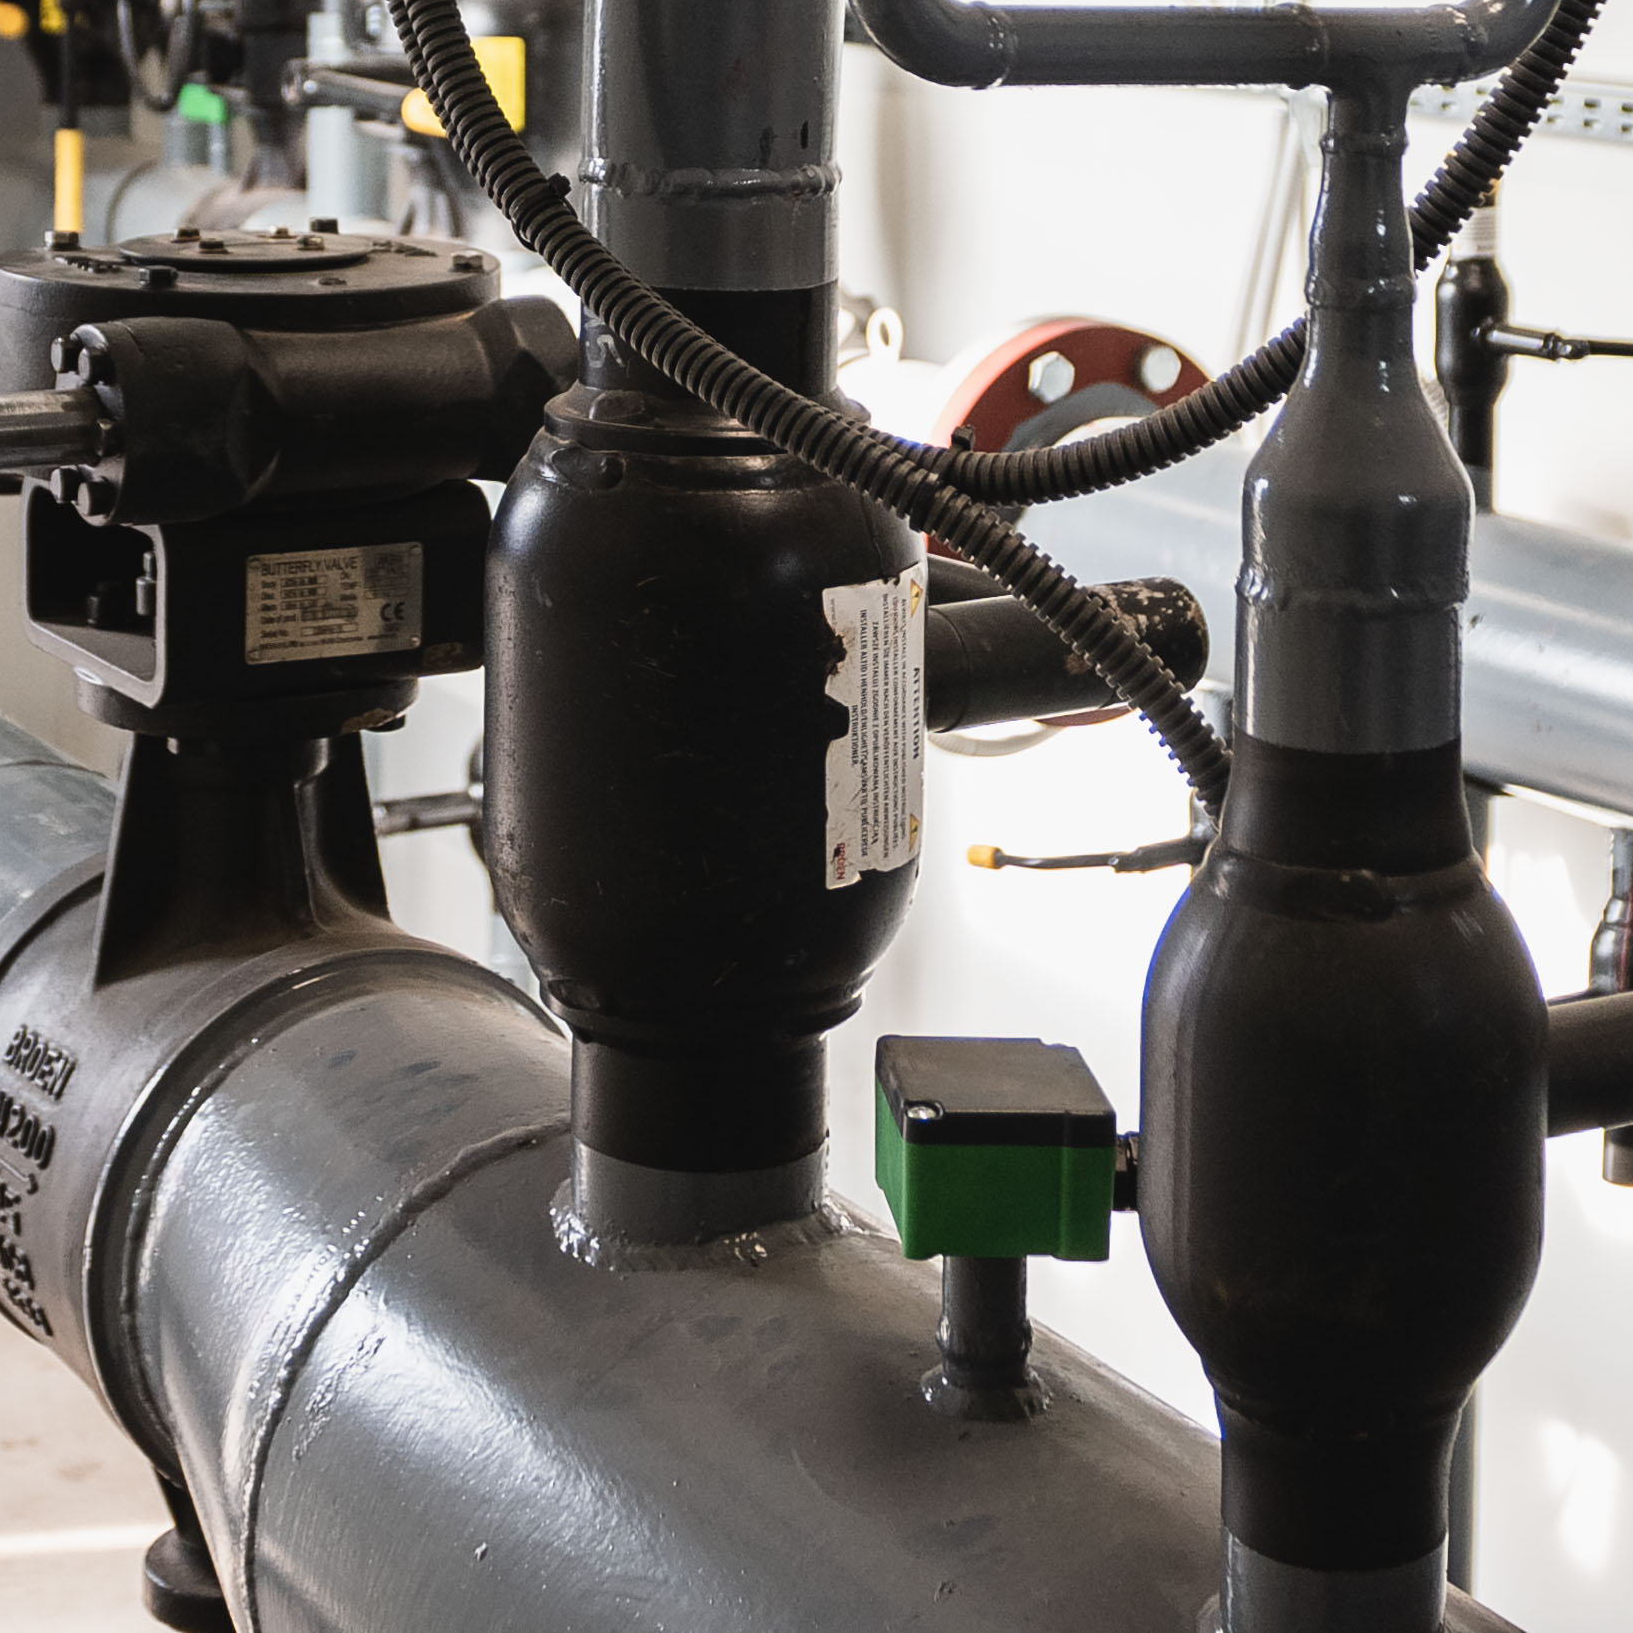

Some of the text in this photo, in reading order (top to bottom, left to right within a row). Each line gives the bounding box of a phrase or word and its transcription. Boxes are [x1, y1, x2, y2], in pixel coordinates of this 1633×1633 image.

[260, 556, 359, 577] BUTTERFLY VALVE
[913, 666, 921, 759] ATTENTION
[2, 1024, 75, 1100] BROEN
